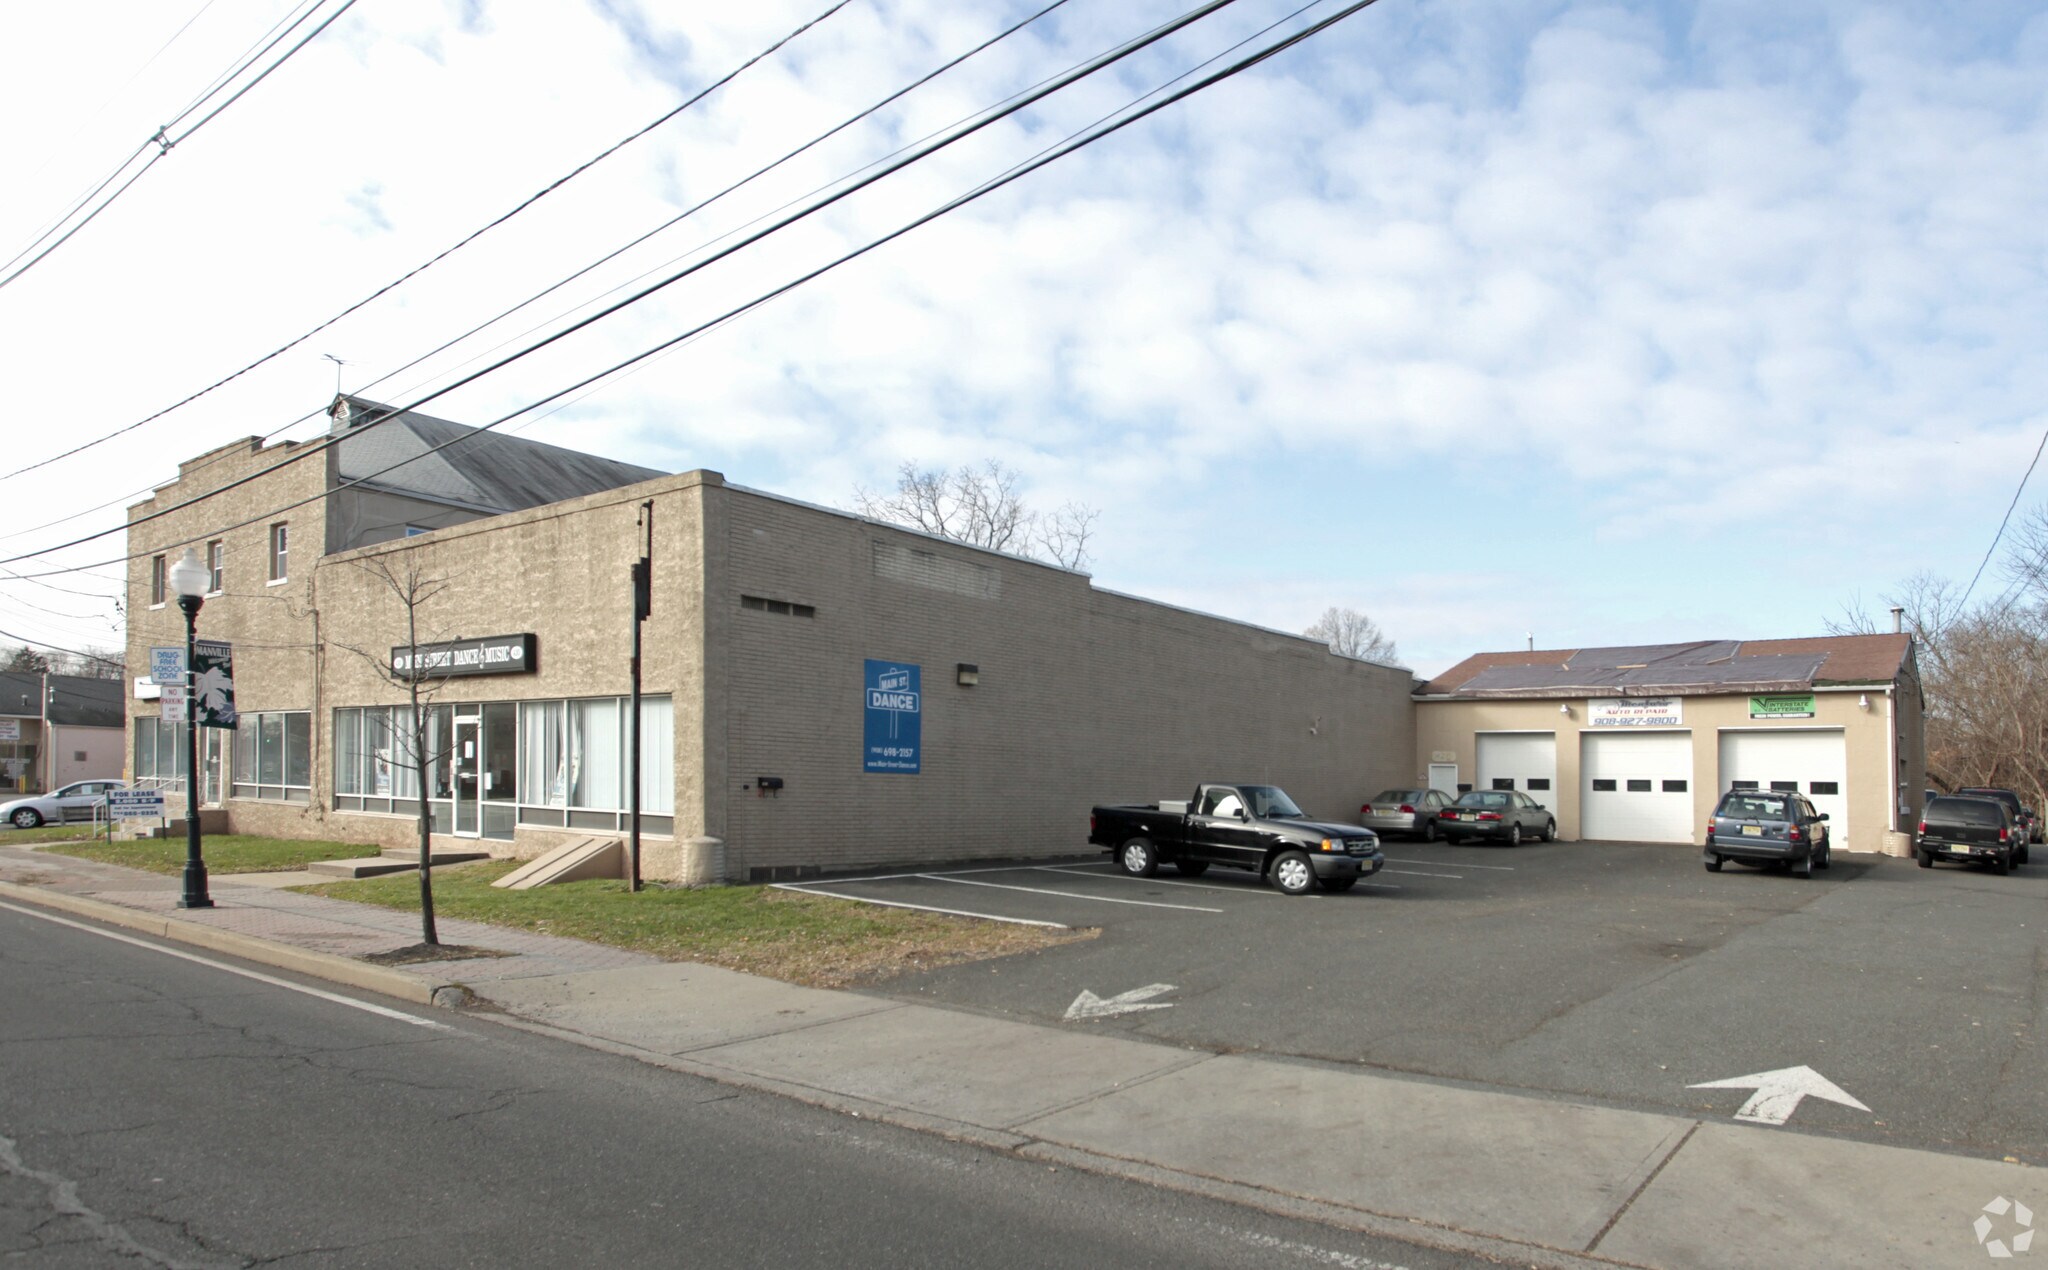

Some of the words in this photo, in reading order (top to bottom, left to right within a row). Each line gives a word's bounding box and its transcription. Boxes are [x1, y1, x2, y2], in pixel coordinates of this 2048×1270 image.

[196, 645, 231, 657] MANVILLE
[405, 653, 423, 669] MIN
[454, 648, 479, 666] DANCE
[485, 646, 510, 663] MUSIC
[153, 665, 183, 673] SCHOOL
[881, 679, 898, 690] MAIN
[872, 692, 914, 710] DANCE
[1593, 716, 1678, 726] 908-927-9800
[883, 748, 914, 758] 698-2157
